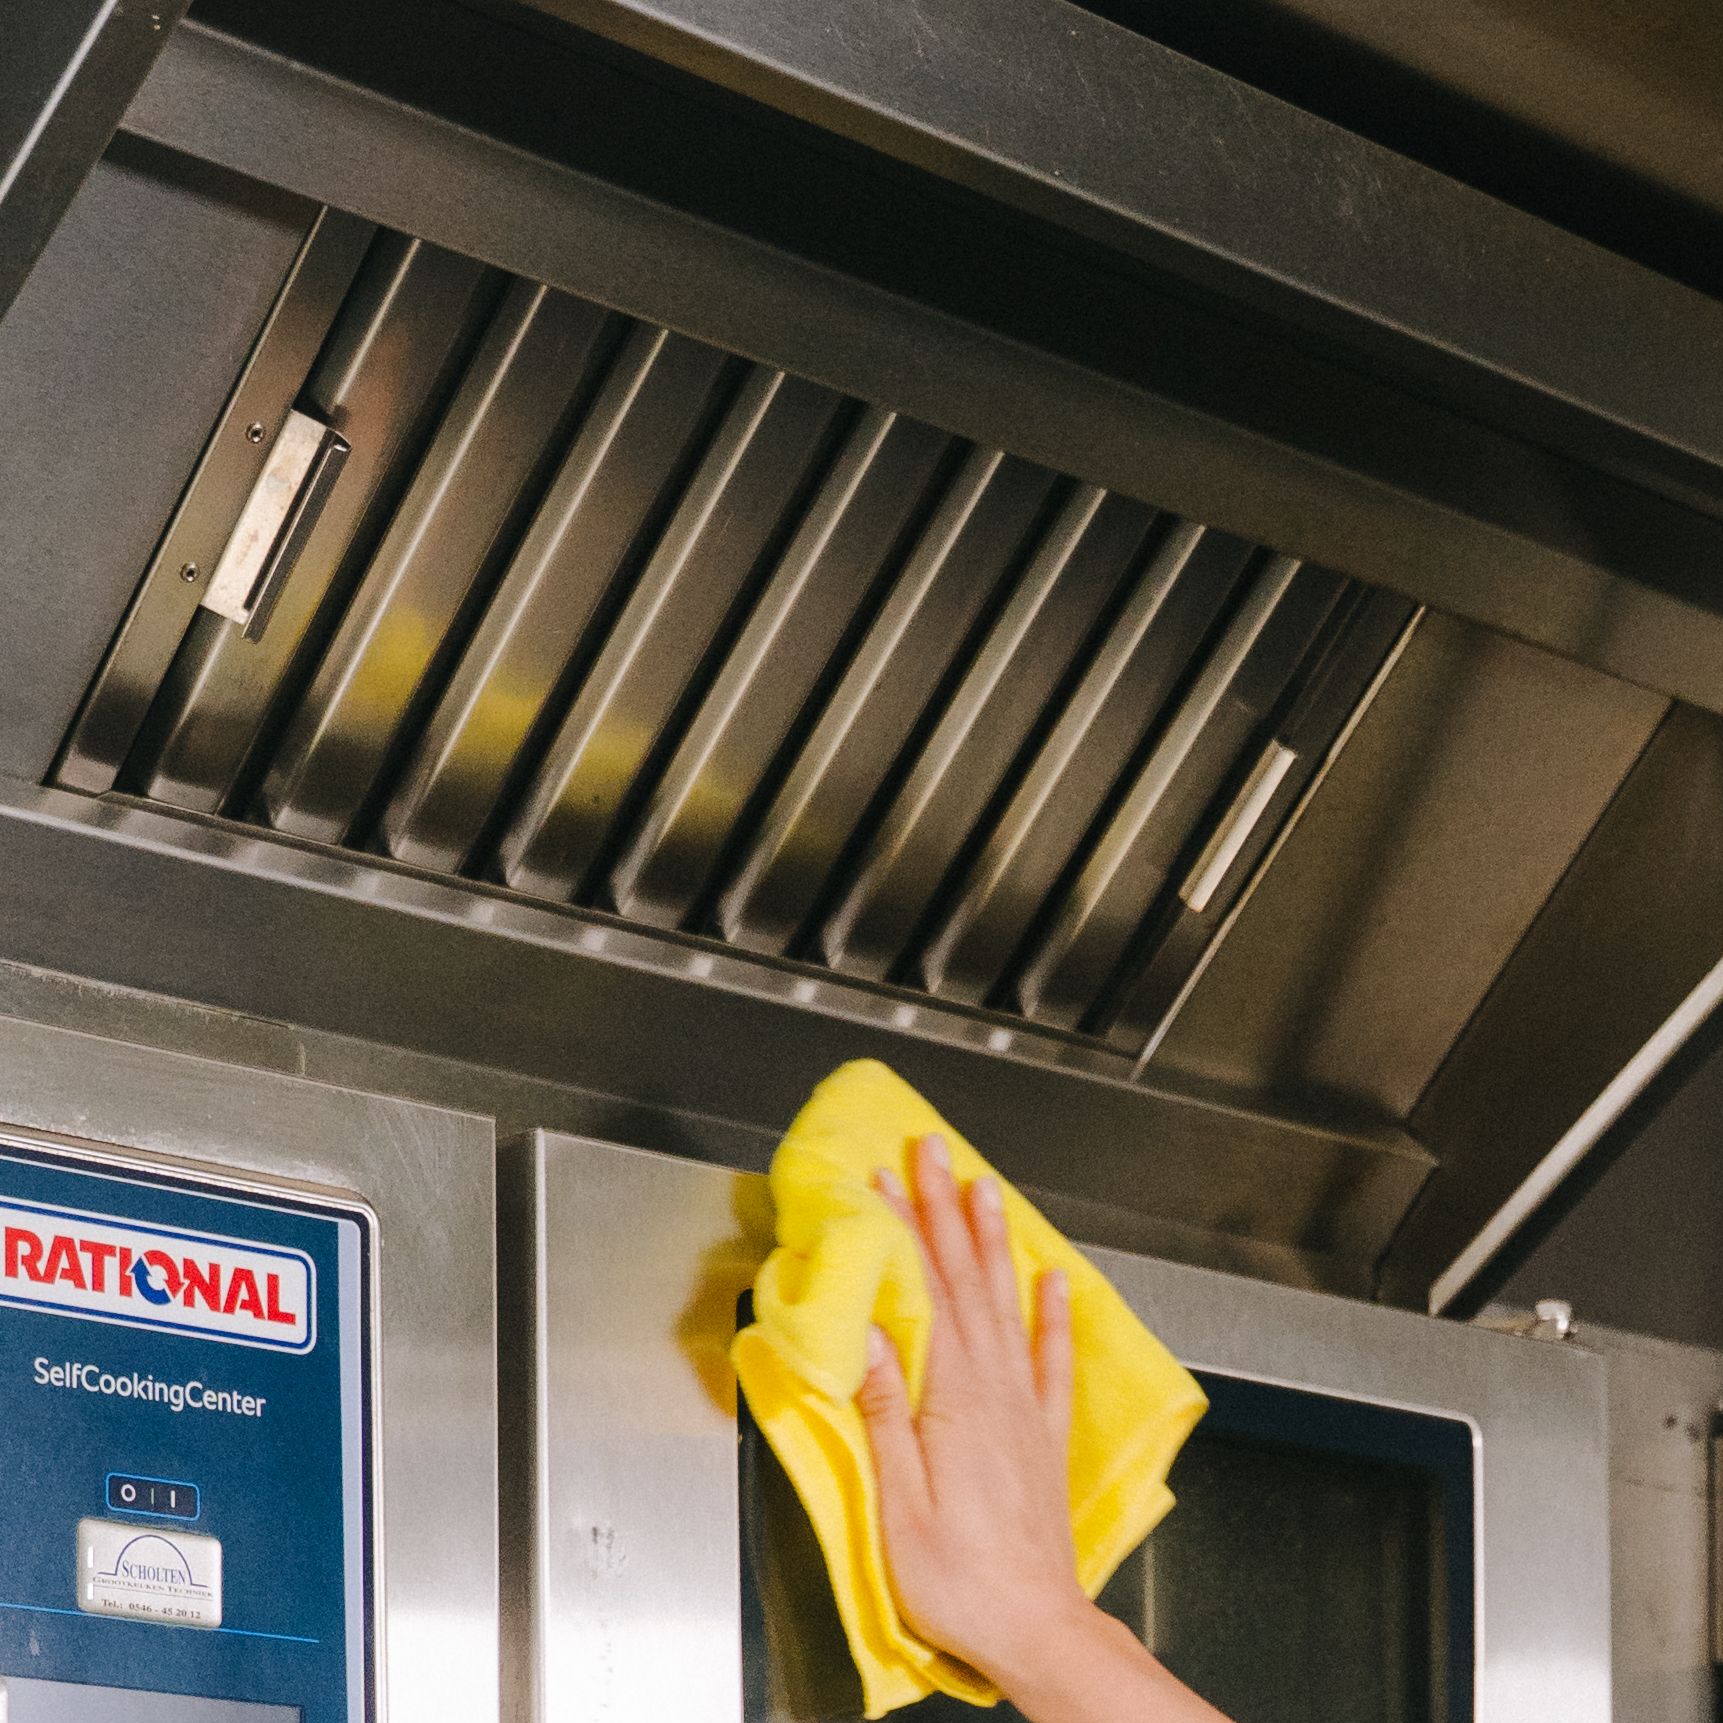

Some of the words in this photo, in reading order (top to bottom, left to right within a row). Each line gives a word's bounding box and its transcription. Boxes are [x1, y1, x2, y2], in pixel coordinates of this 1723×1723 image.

[4, 1226, 296, 1326] RATIONAL
[33, 1356, 266, 1417] SelfCookingCenter
[122, 1560, 187, 1585] SCHOLTEN
[129, 1603, 152, 1613] 0546
[161, 1607, 173, 1616] 45
[176, 1608, 188, 1618] 20
[190, 1610, 202, 1619] 12
